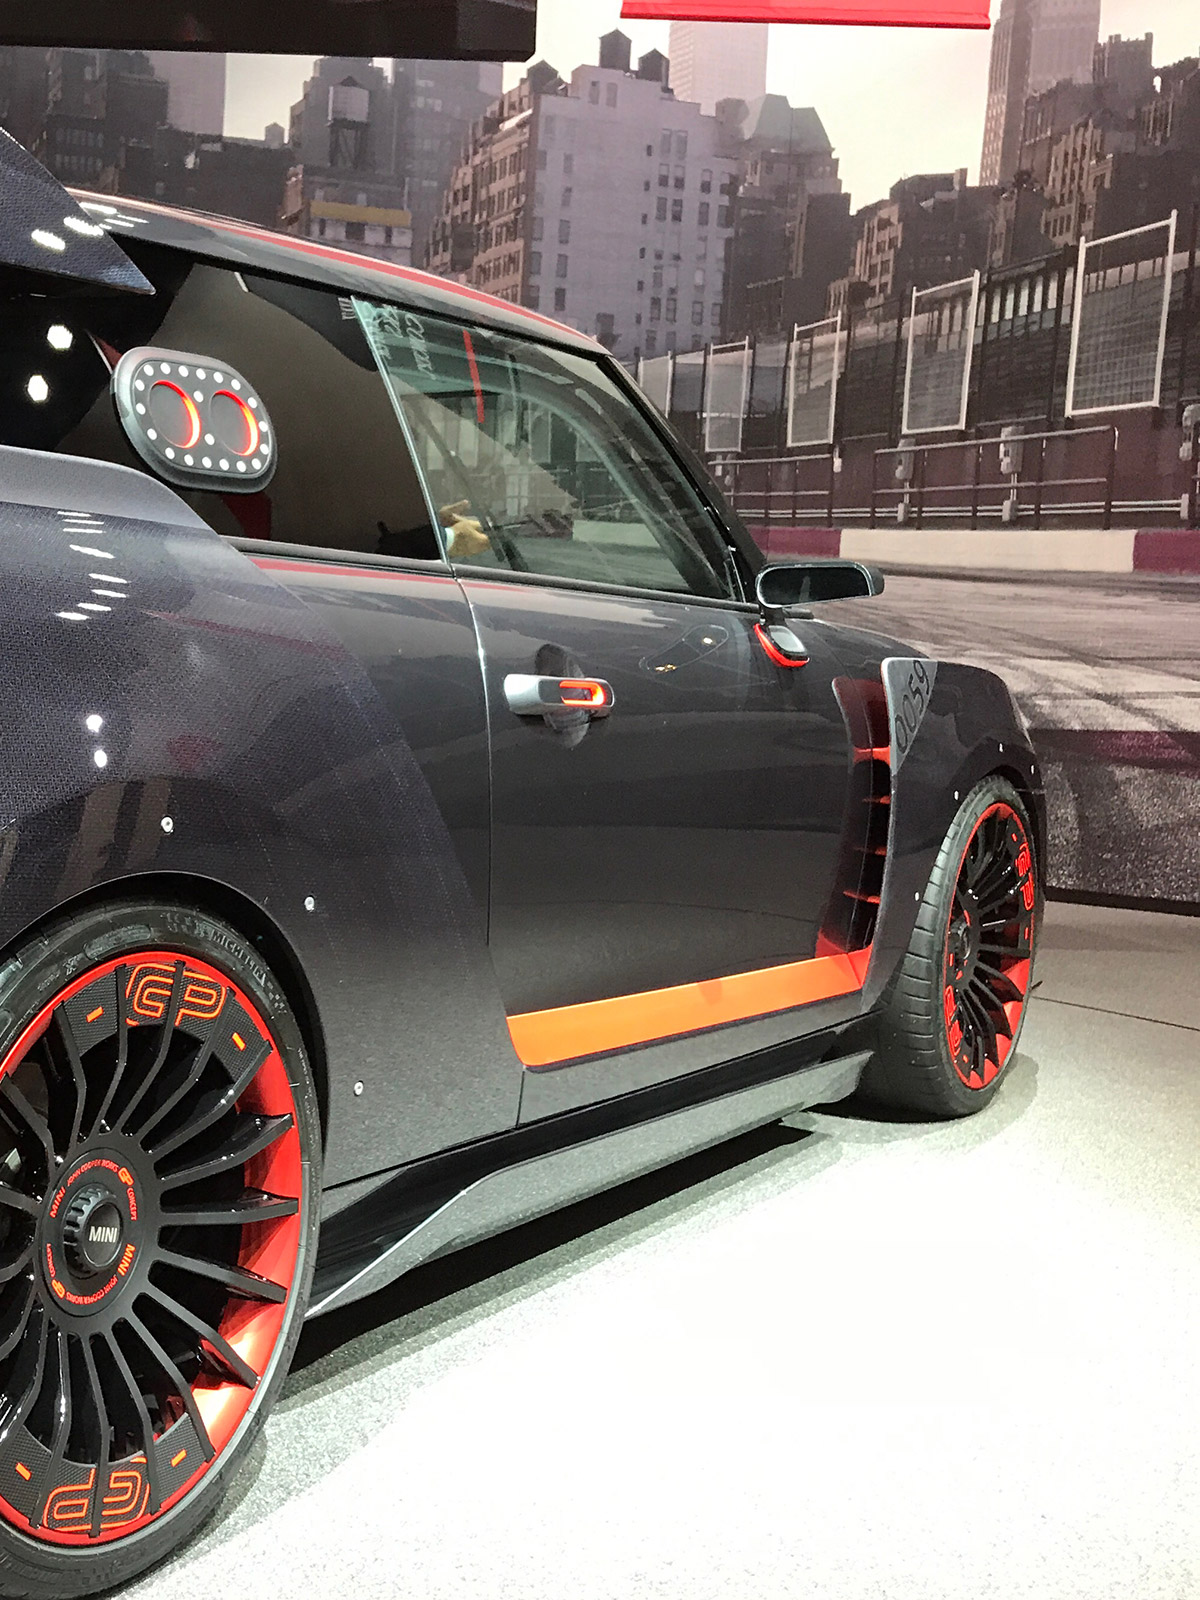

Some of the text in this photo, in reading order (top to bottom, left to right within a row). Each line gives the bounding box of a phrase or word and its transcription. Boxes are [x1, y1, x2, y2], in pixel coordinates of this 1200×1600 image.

[126, 963, 226, 1027] GP
[49, 1186, 66, 1218] MINI
[89, 1226, 118, 1243] MINI
[117, 1243, 136, 1276] MINI
